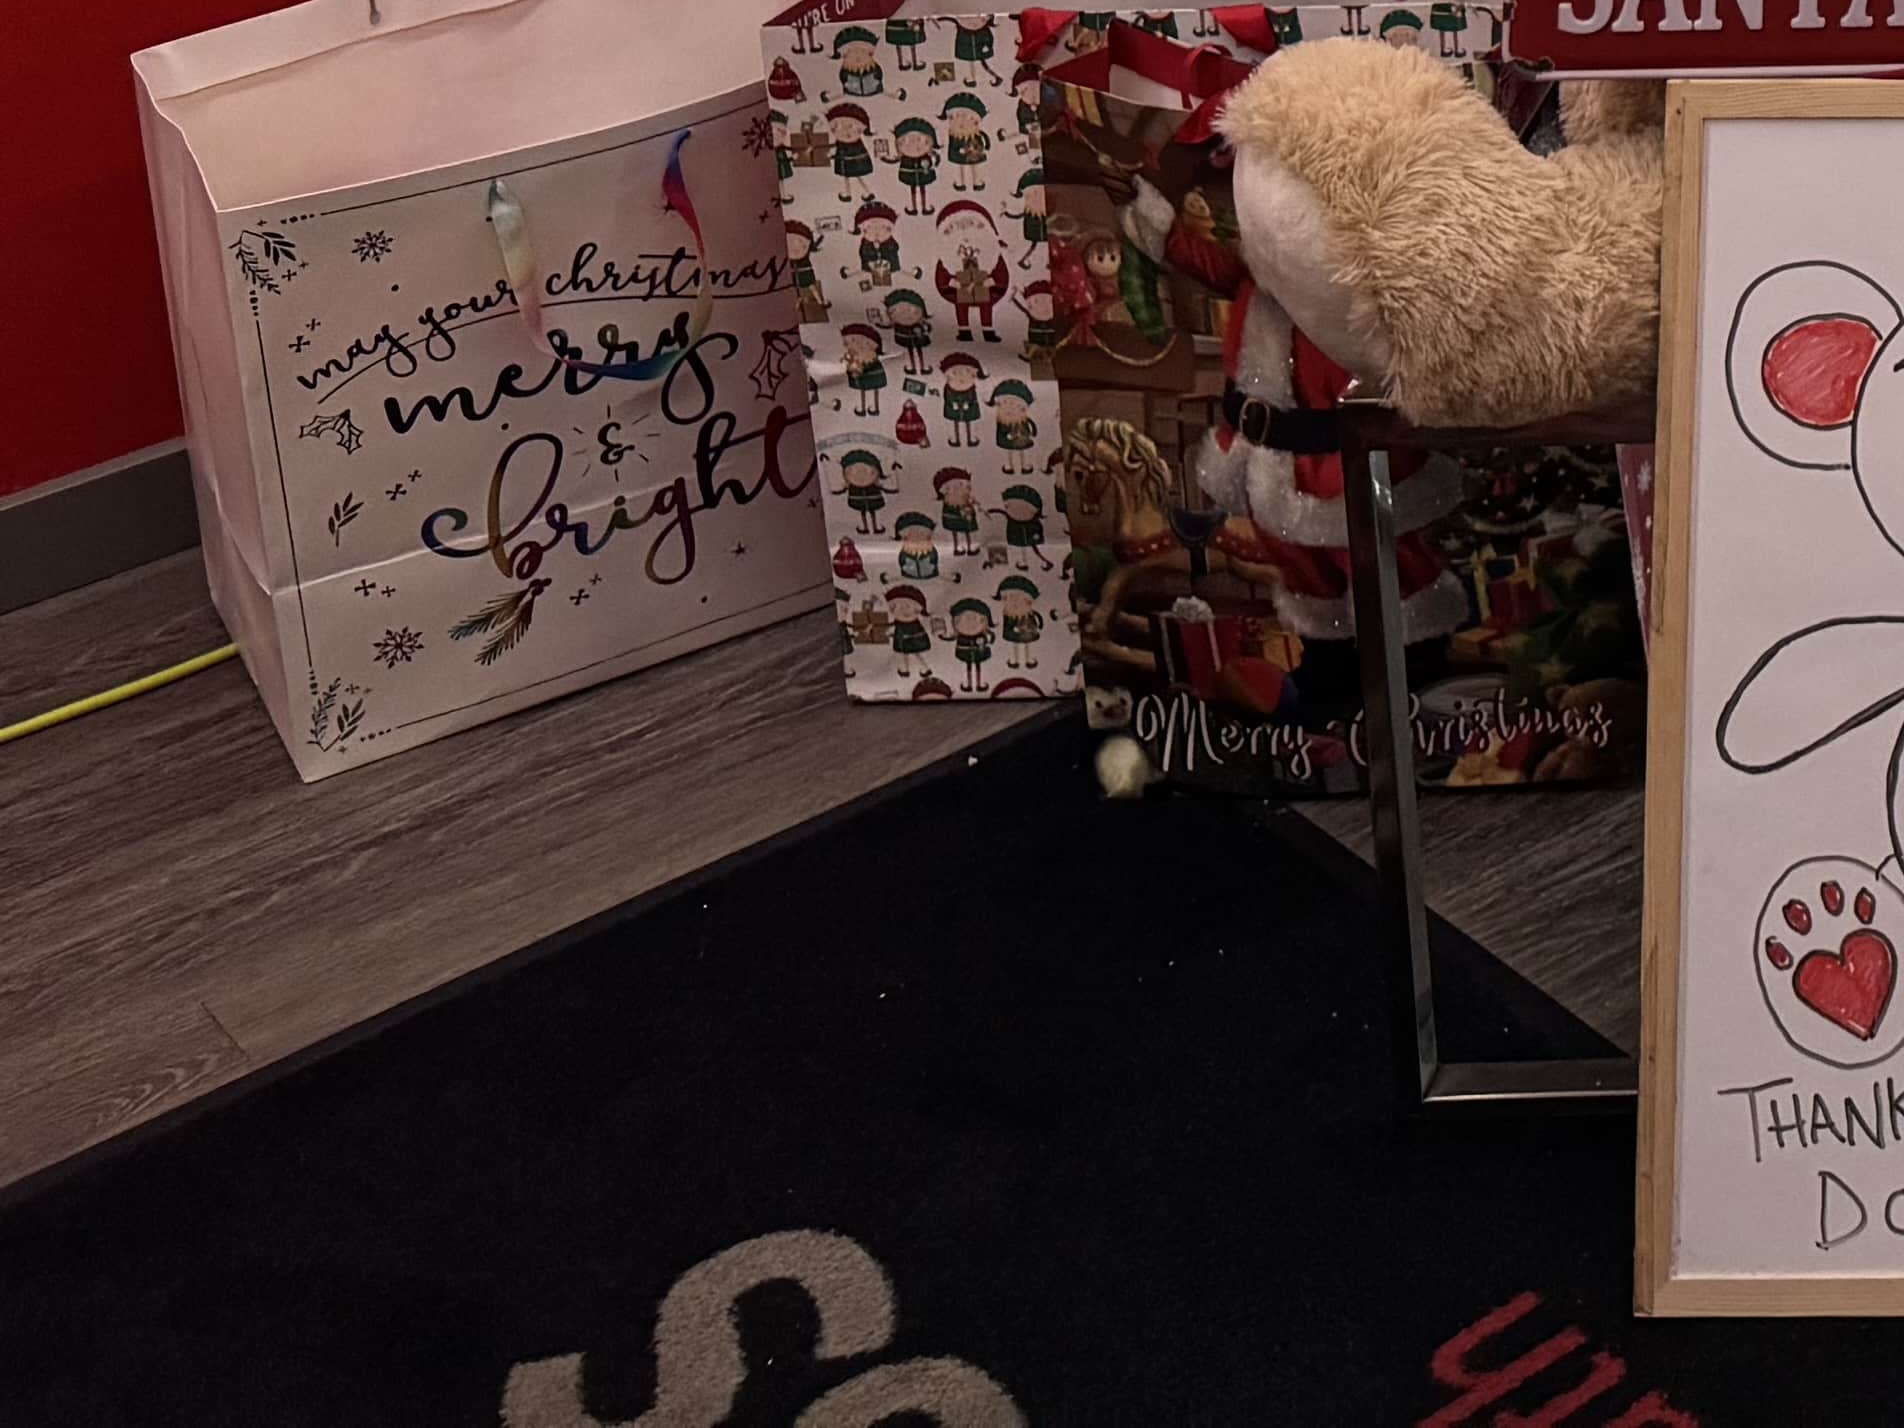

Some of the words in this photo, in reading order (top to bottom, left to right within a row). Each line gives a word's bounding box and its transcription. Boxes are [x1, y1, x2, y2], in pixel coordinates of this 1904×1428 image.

[295, 319, 418, 392] may
[415, 275, 518, 362] your
[544, 241, 793, 302] christmas
[385, 311, 741, 436] merry
[420, 409, 819, 586] bright
[598, 419, 635, 468] &
[1135, 692, 1314, 781] Merry
